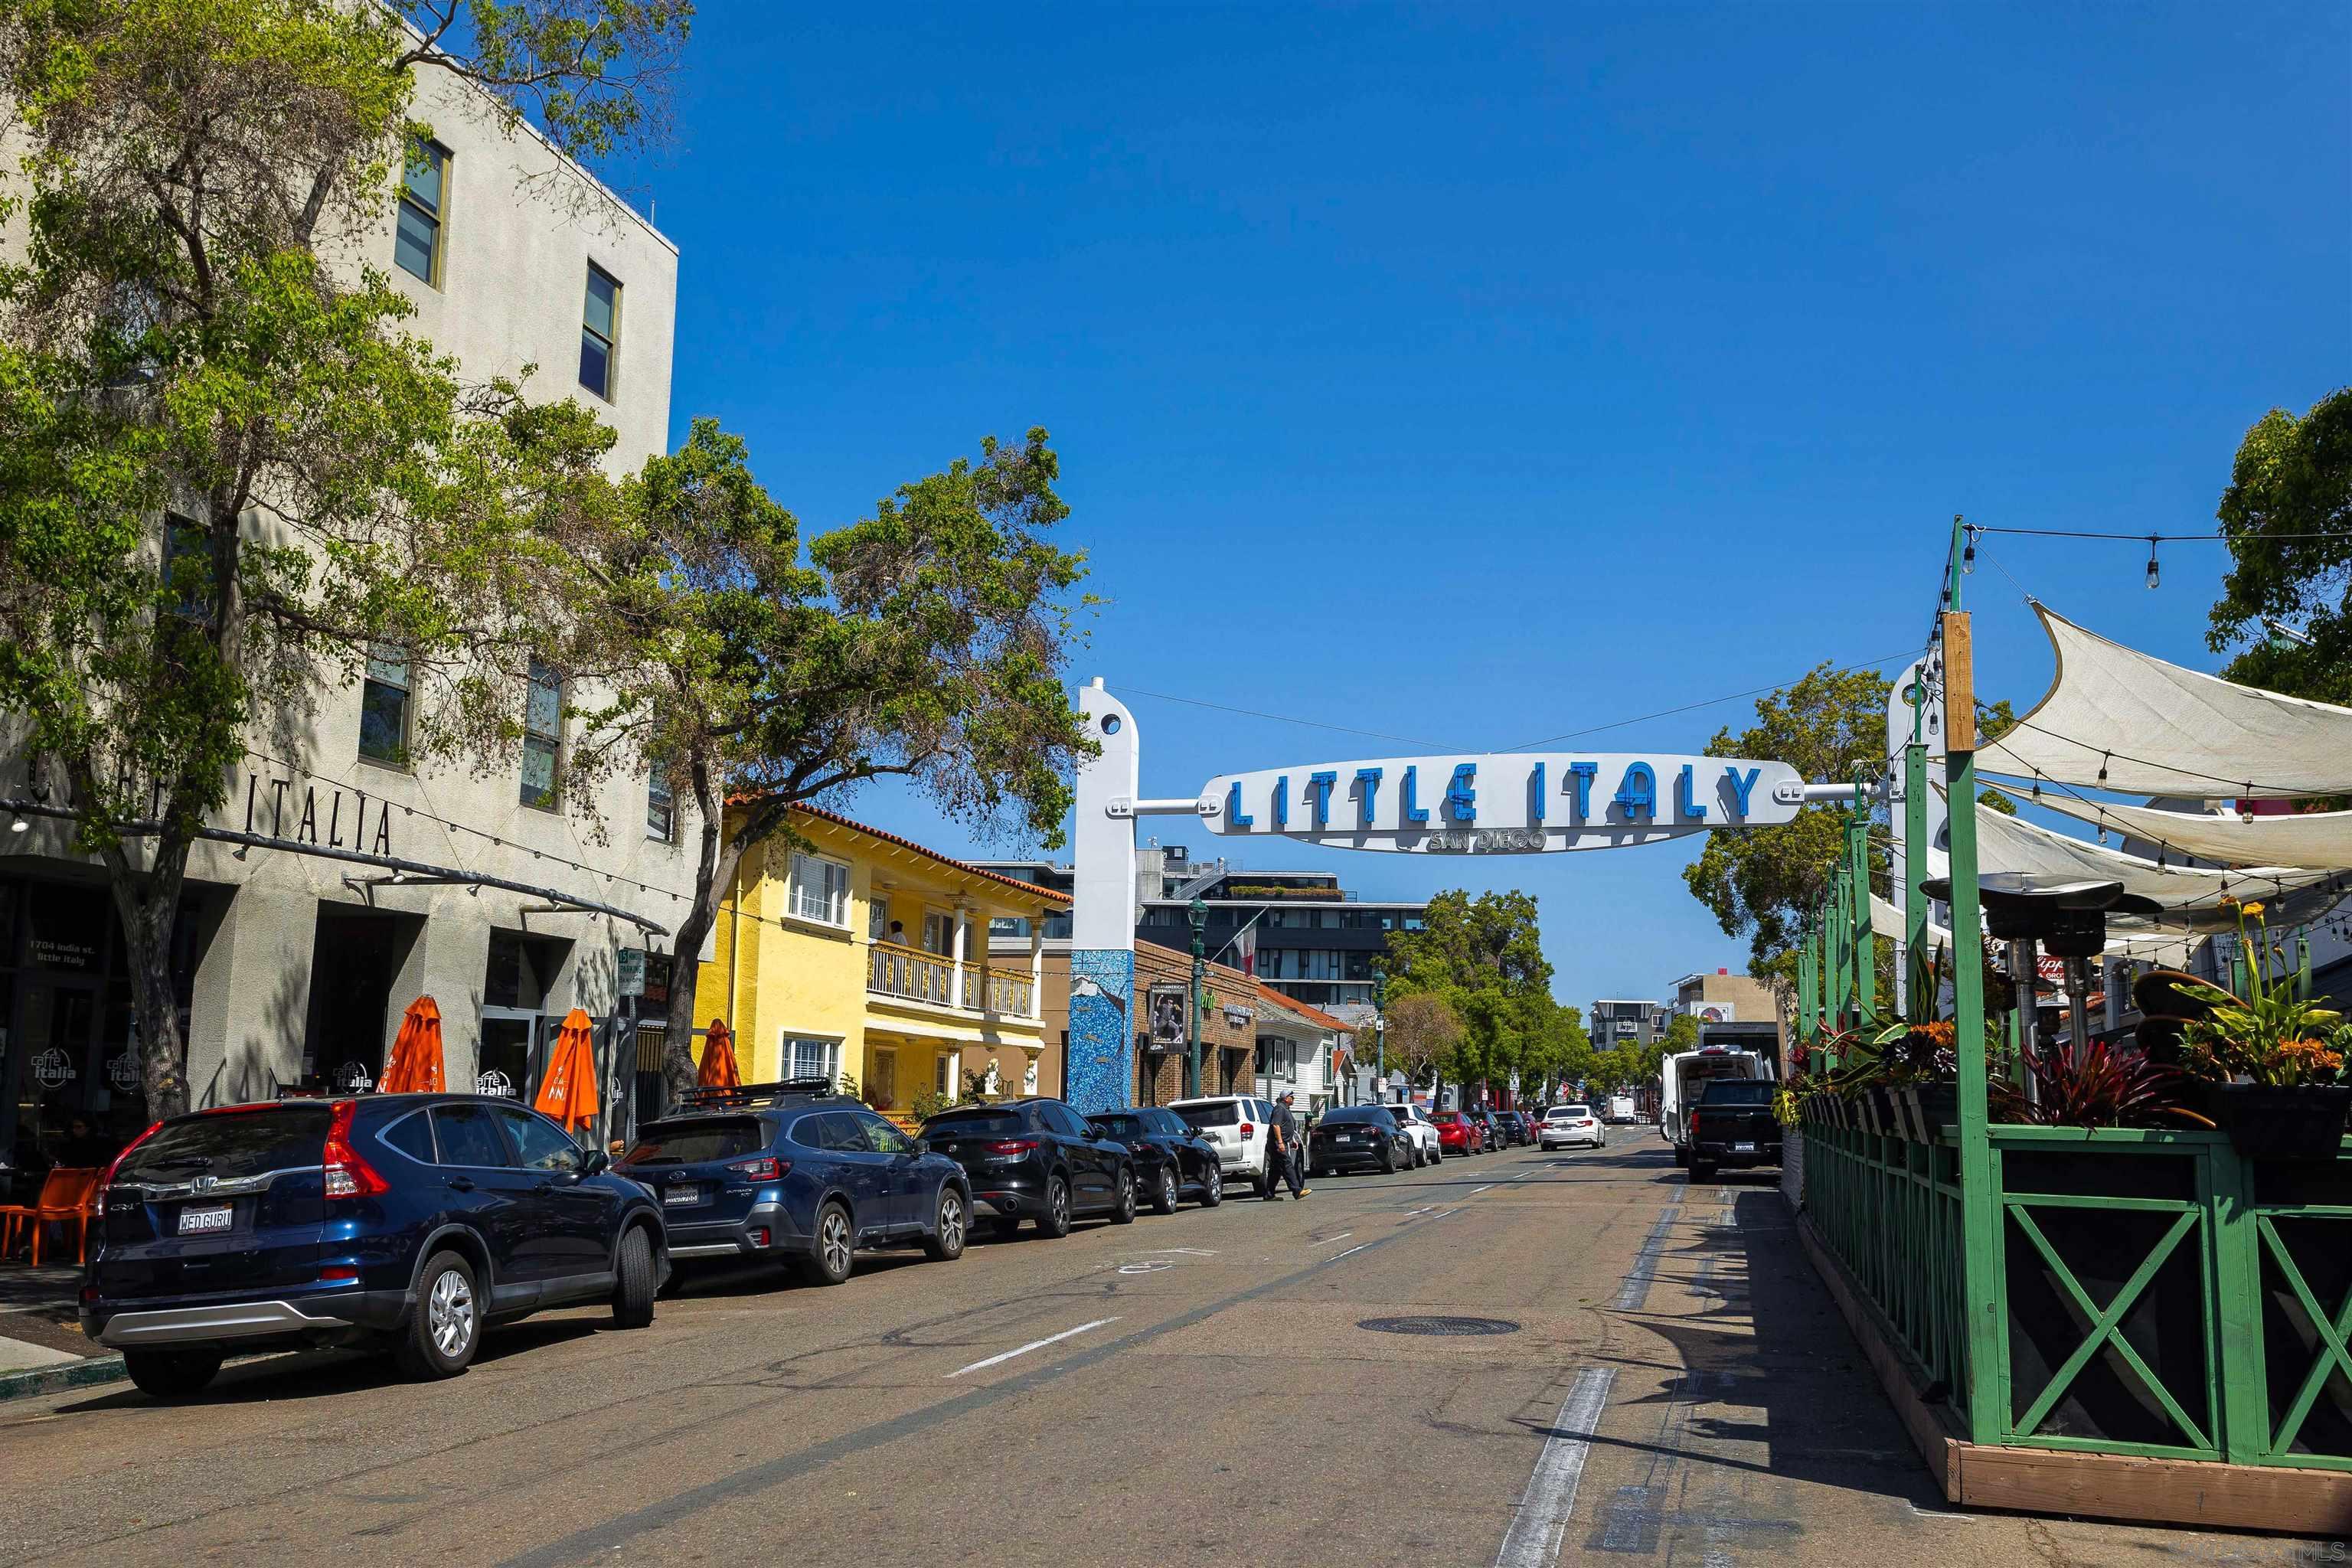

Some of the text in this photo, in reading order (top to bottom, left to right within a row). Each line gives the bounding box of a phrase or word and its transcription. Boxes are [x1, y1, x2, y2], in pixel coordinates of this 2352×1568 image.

[1231, 761, 1762, 827] LITTLE ITALY
[245, 774, 390, 855] ITALIA
[1430, 829, 1547, 850] SAN DIEGO
[31, 940, 54, 950] 1704
[619, 951, 627, 962] 15
[619, 965, 642, 974] PARKING
[1200, 988, 1217, 1010] erde
[34, 1067, 77, 1079] italia
[110, 1070, 142, 1082] itali
[203, 1211, 231, 1229] GURU
